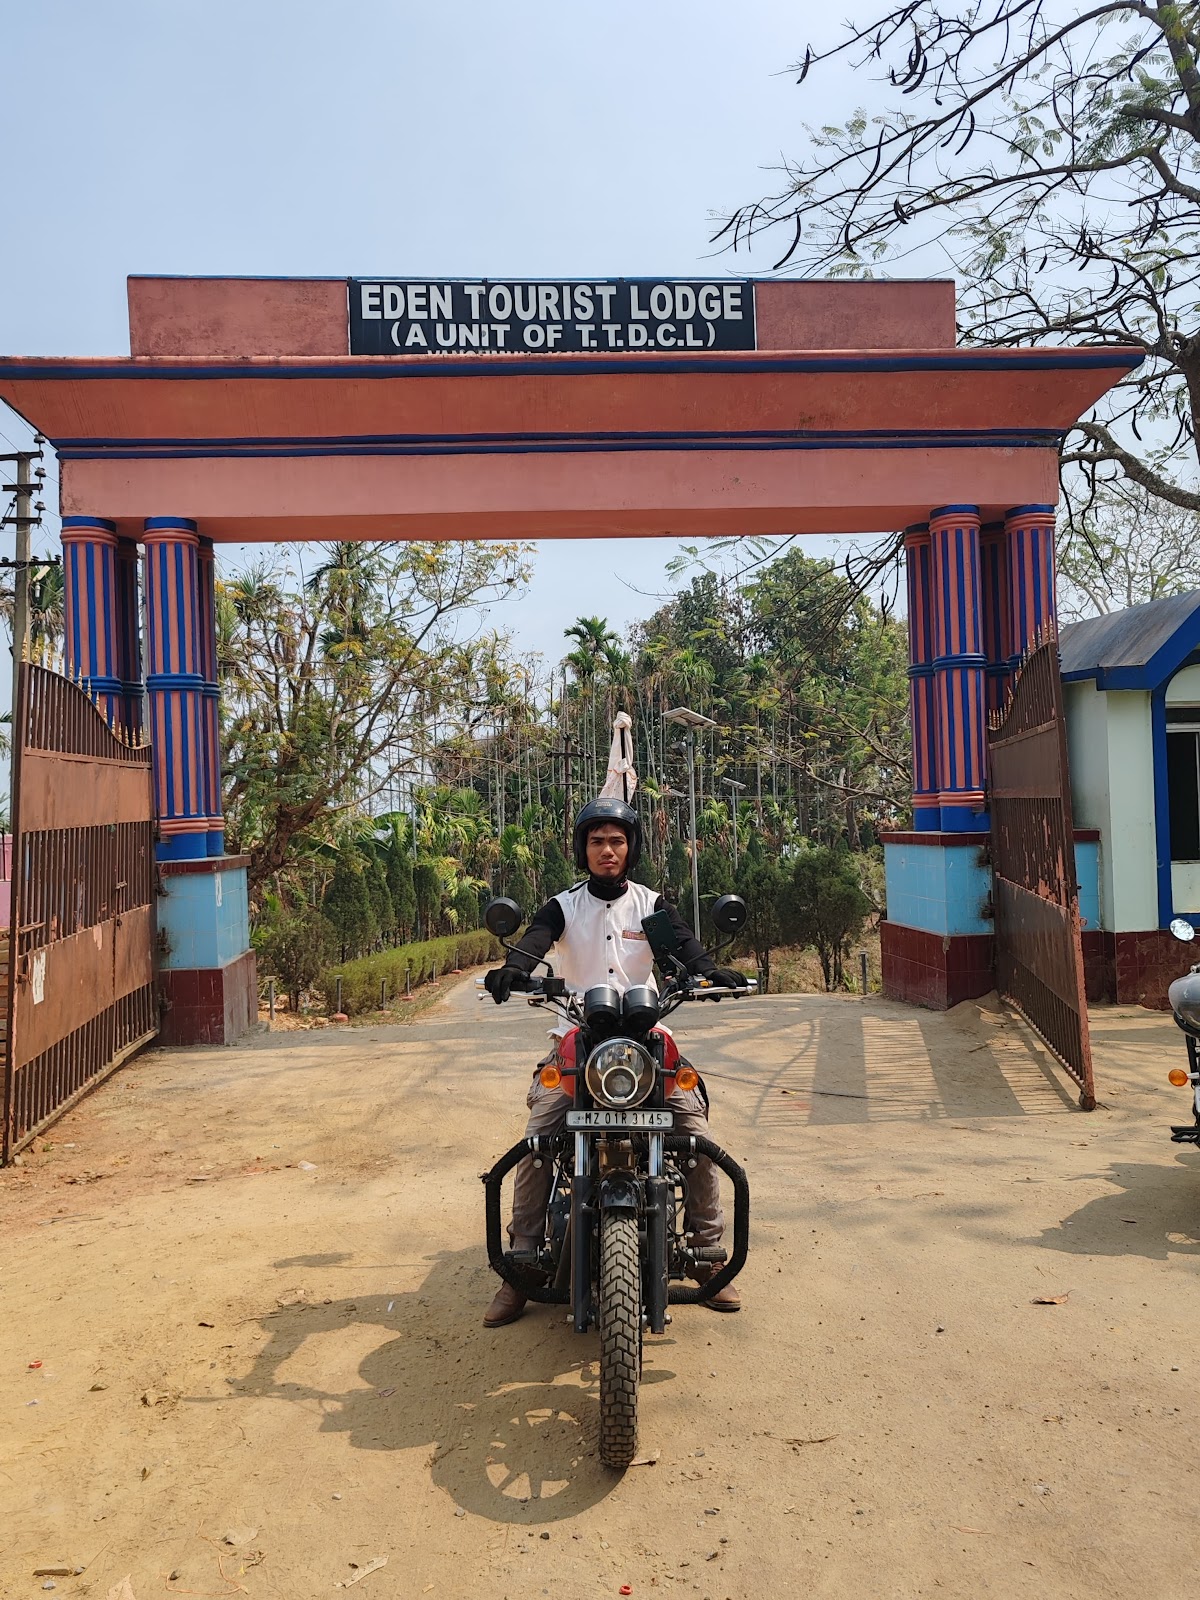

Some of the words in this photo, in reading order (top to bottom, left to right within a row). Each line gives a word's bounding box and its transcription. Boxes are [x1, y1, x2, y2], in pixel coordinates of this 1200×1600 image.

[361, 285, 453, 320] EDEN
[464, 285, 617, 321] TOURIST
[629, 284, 743, 320] LODGE
[436, 323, 511, 347] UNIT
[523, 323, 563, 348] OF
[632, 1112, 663, 1125] 3145
